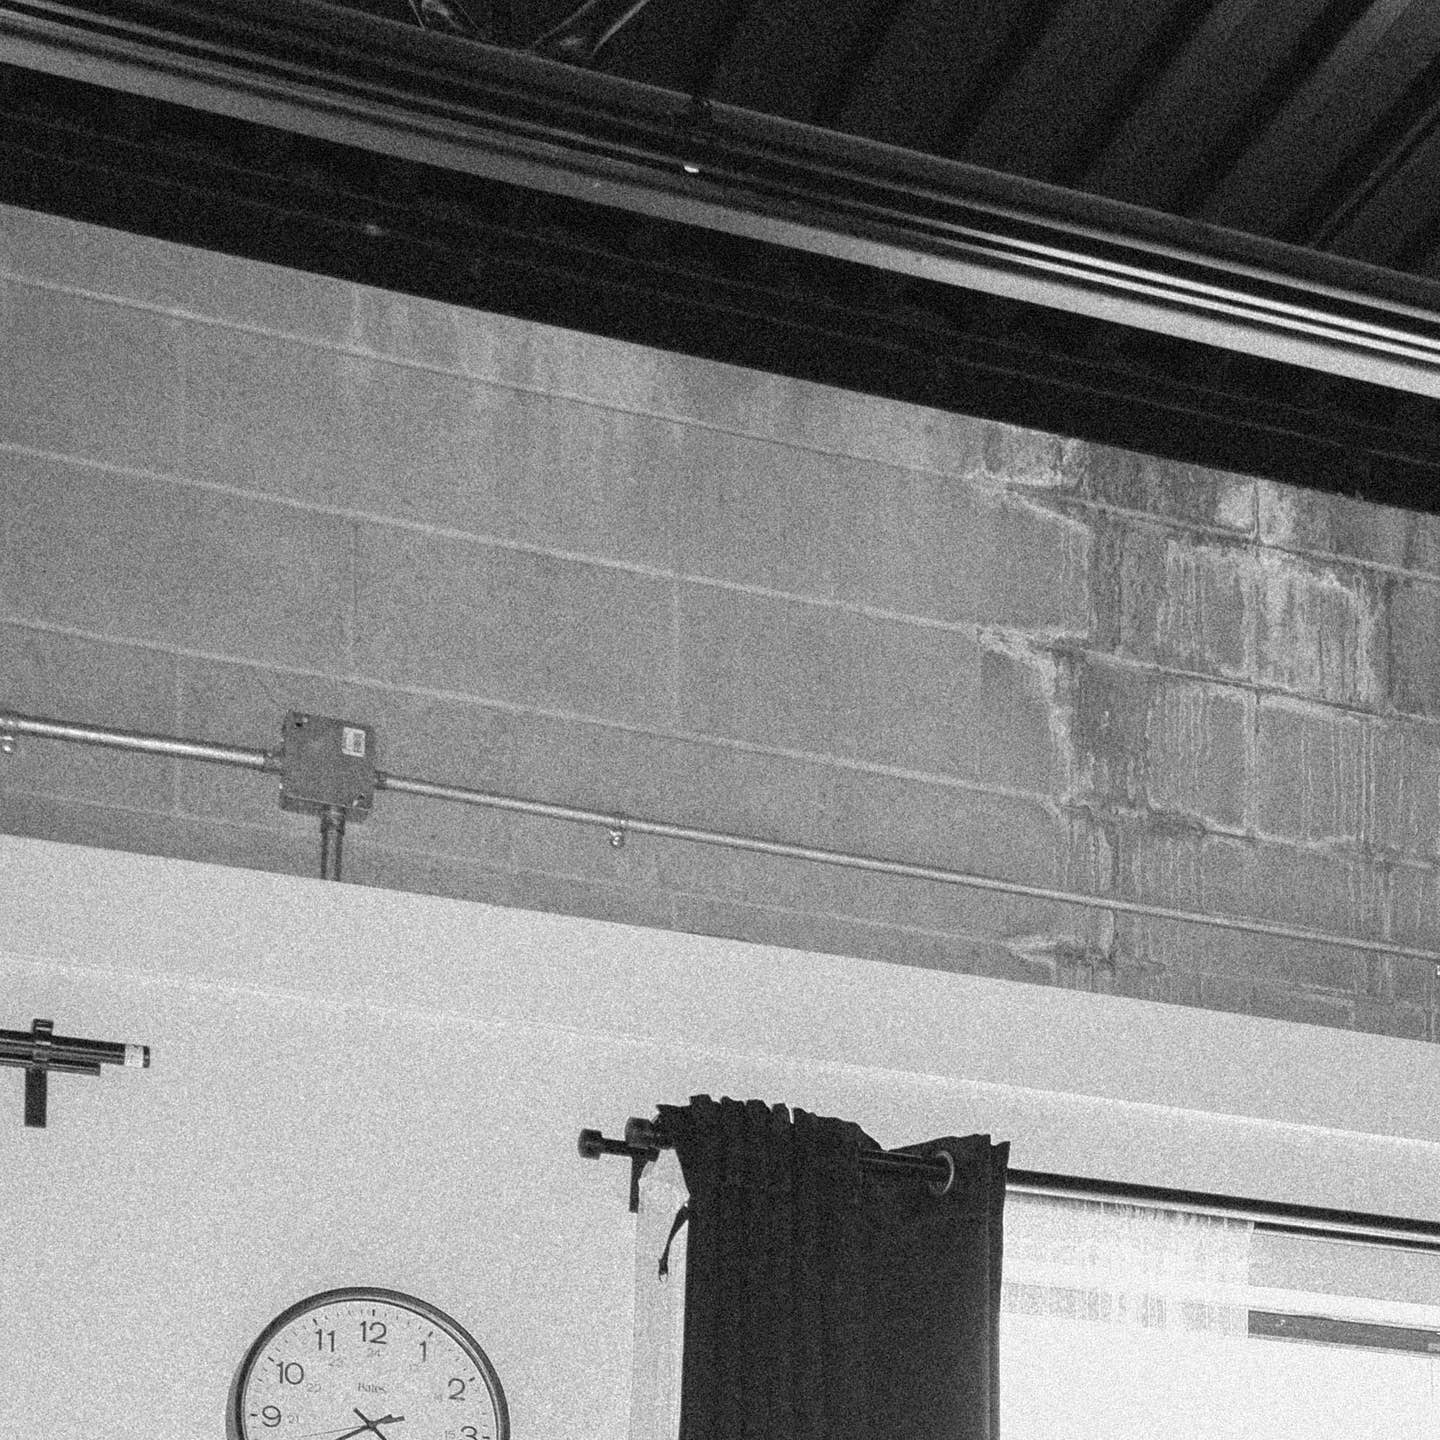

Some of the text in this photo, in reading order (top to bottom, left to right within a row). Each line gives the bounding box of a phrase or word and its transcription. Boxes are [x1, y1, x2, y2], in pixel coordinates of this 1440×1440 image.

[315, 1329, 335, 1353] 11
[360, 1321, 387, 1344] 12
[419, 1340, 427, 1362] 1
[276, 1361, 304, 1385] 10
[447, 1378, 466, 1401] 2
[262, 1405, 281, 1428] 9
